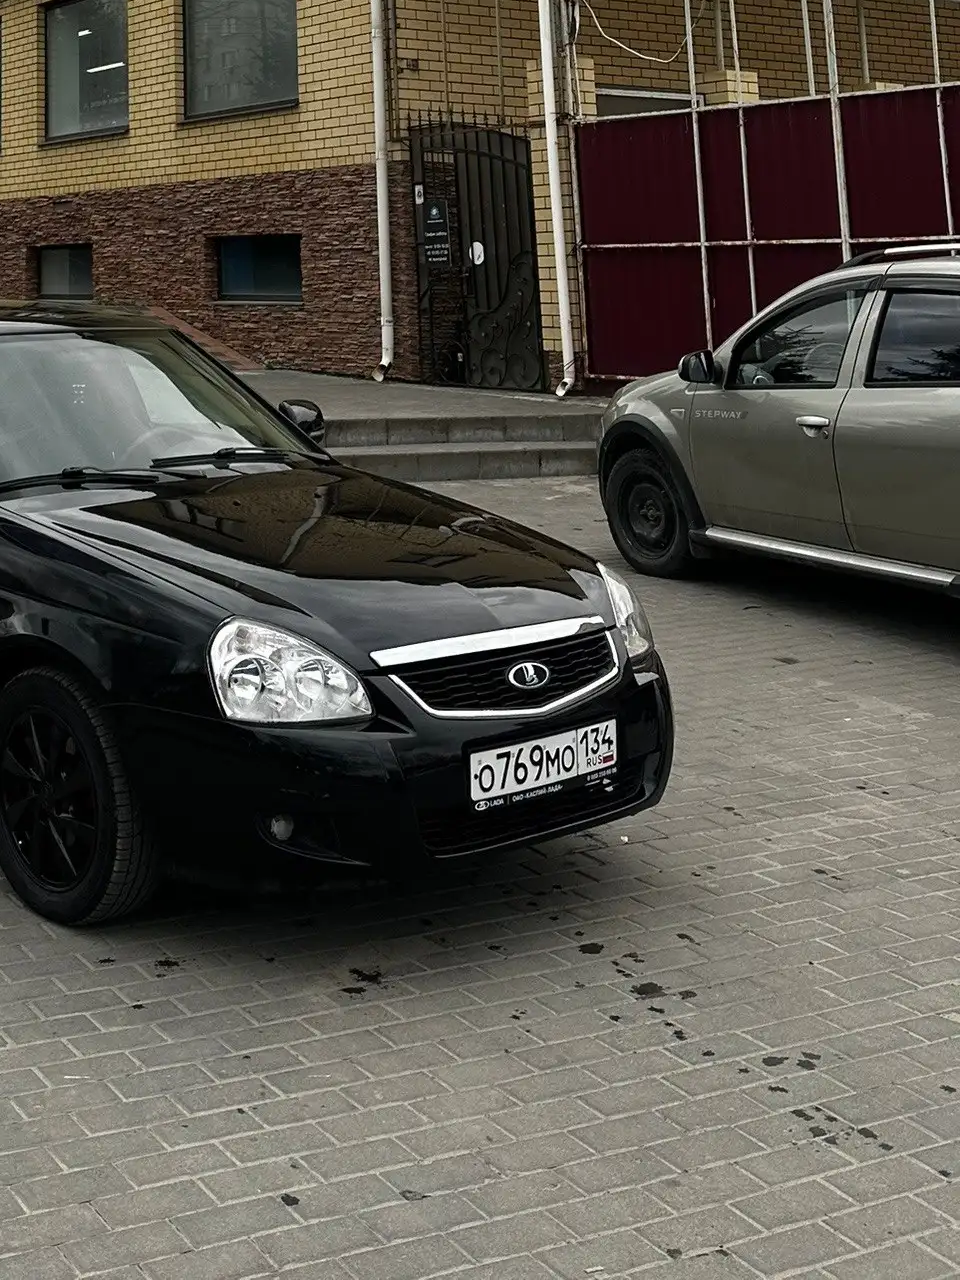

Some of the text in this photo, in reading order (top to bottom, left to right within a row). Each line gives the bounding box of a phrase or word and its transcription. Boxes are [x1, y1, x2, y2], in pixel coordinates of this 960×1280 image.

[695, 410, 742, 419] STEPWAY
[579, 725, 614, 758] 134
[586, 754, 603, 768] RUS
